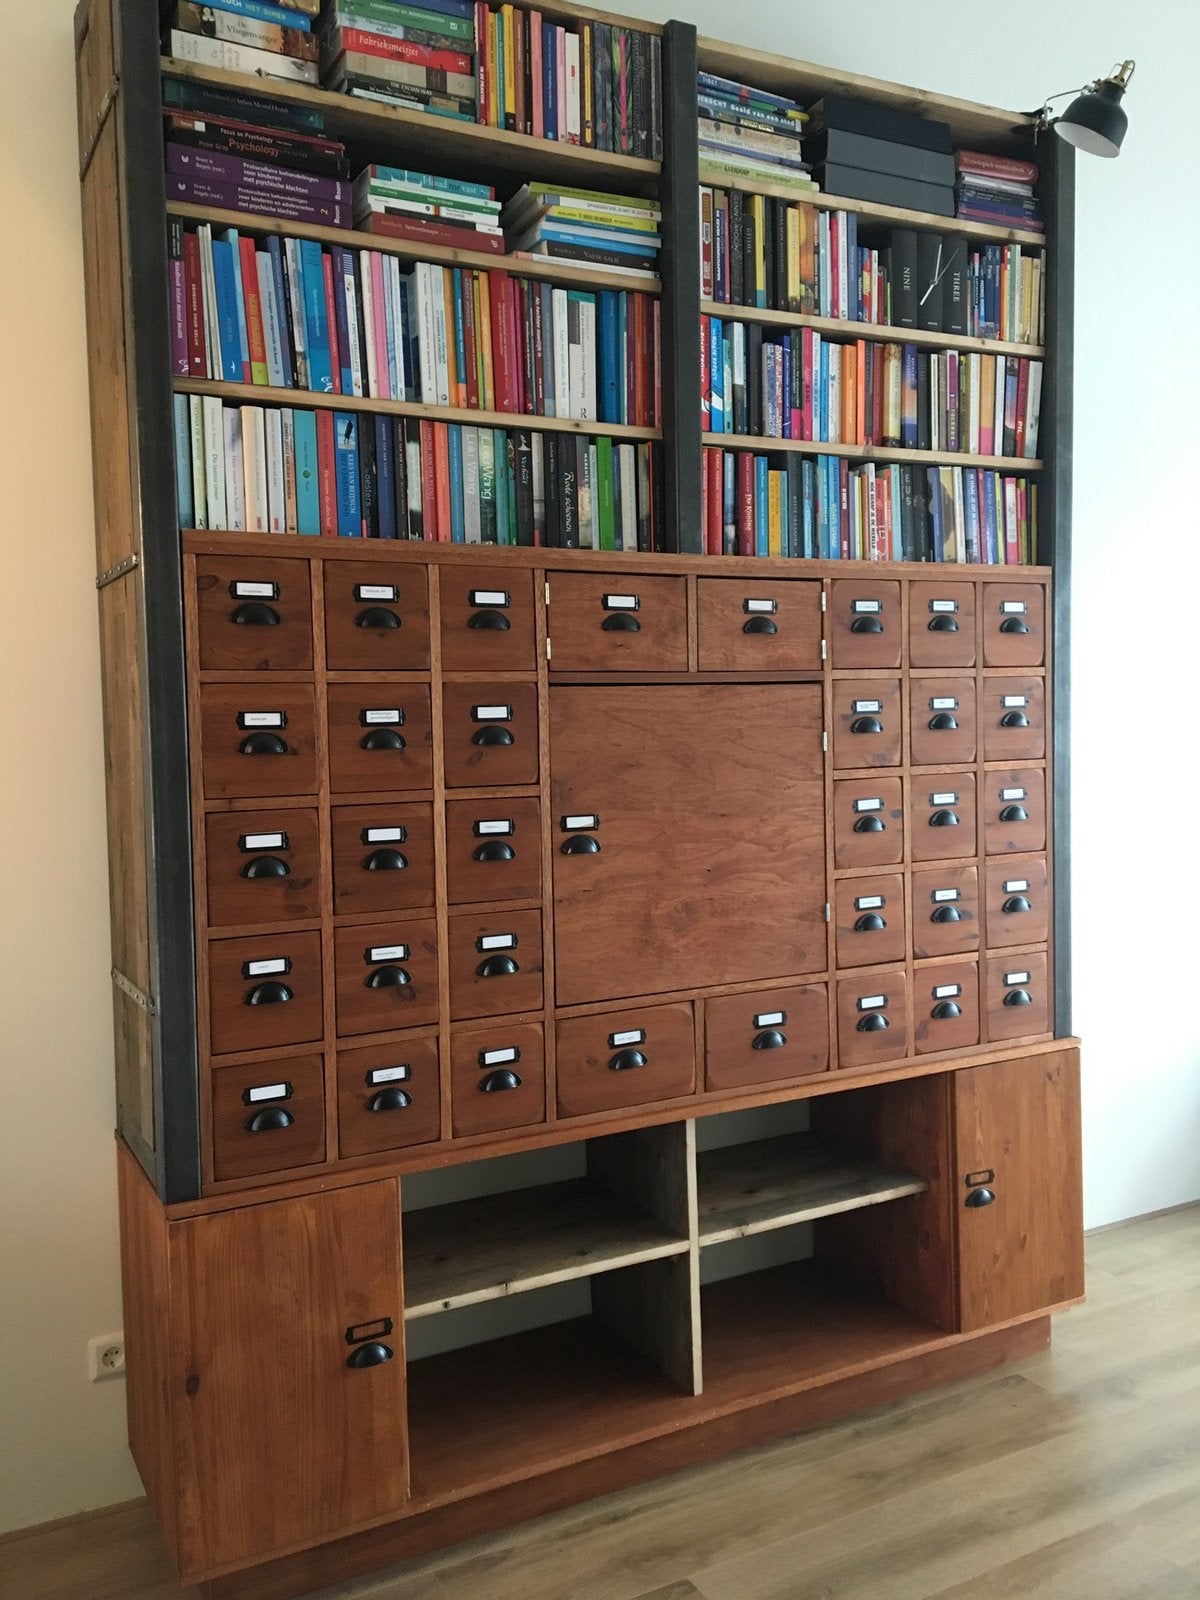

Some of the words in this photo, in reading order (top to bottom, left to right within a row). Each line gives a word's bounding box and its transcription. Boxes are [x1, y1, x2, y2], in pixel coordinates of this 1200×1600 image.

[359, 35, 419, 57] Fabrieksmeisjes
[731, 102, 751, 115] Beeld
[752, 110, 765, 119] van
[766, 114, 778, 122] een
[781, 116, 795, 127] stad
[229, 138, 280, 158] Psychology
[245, 132, 273, 144] Psychology
[243, 162, 277, 175] Protocollaire
[279, 169, 319, 183] behandelingen
[243, 169, 256, 178] voor
[257, 171, 282, 182] kinderen
[243, 176, 254, 184] met
[255, 178, 285, 190] psychische
[285, 184, 309, 194] klachten
[461, 184, 477, 194] vast
[251, 195, 273, 205] kinderen
[271, 193, 308, 205] behandelingen
[277, 207, 299, 216] klachten
[953, 272, 961, 302] THREE
[466, 434, 476, 458] Lulu
[466, 461, 477, 494] Wang
[481, 466, 493, 499] Wang
[564, 472, 574, 495] Rode
[364, 474, 372, 507] oesters
[745, 494, 752, 504] De
[565, 497, 575, 532] schoenen
[744, 506, 752, 530] Koning
